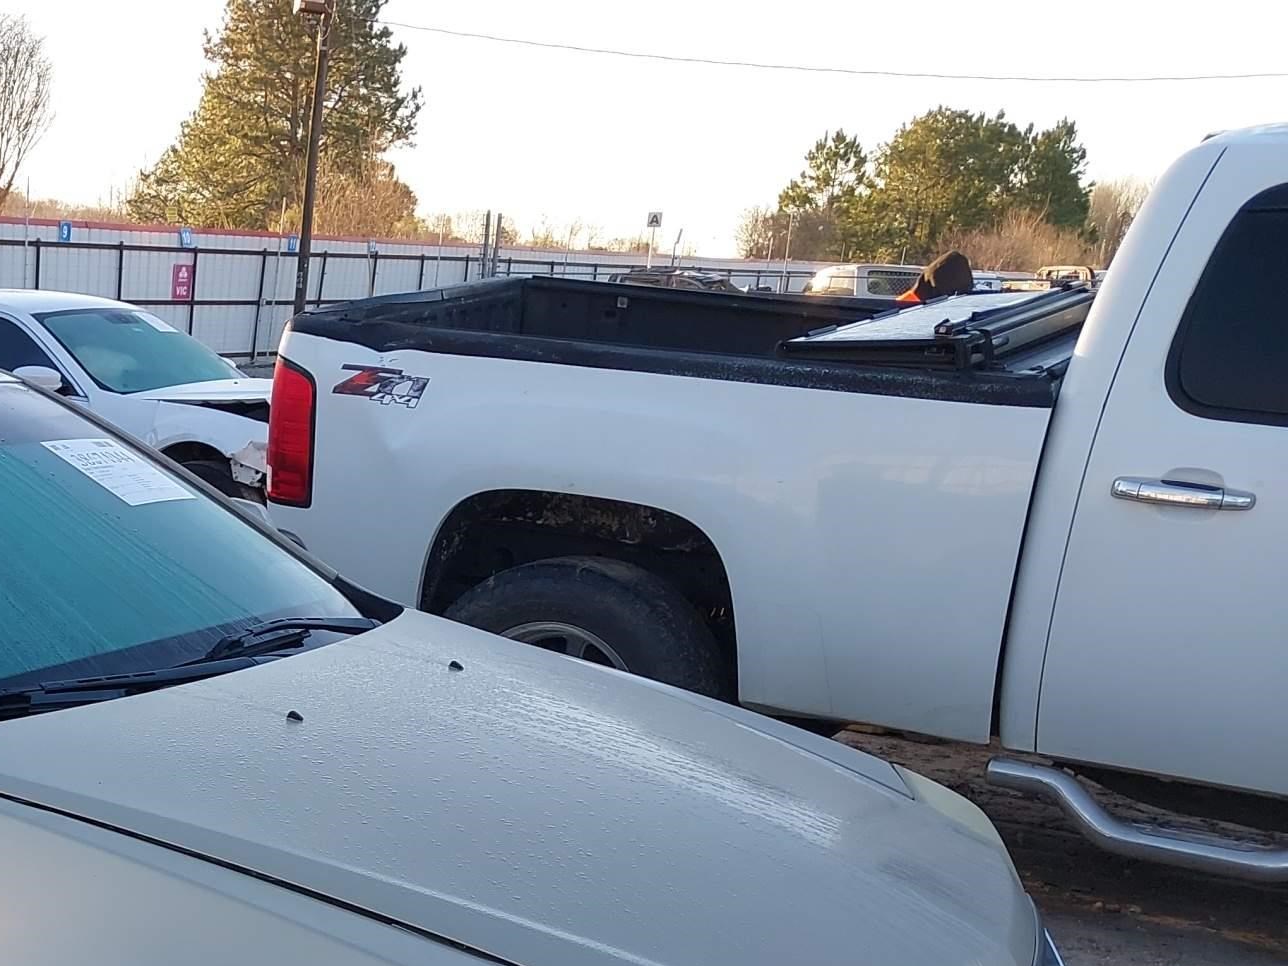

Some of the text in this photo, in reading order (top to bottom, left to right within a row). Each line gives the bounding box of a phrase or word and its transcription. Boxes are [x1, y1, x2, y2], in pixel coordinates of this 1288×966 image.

[649, 214, 660, 225] A
[62, 225, 69, 238] 9
[175, 286, 188, 296] VIC
